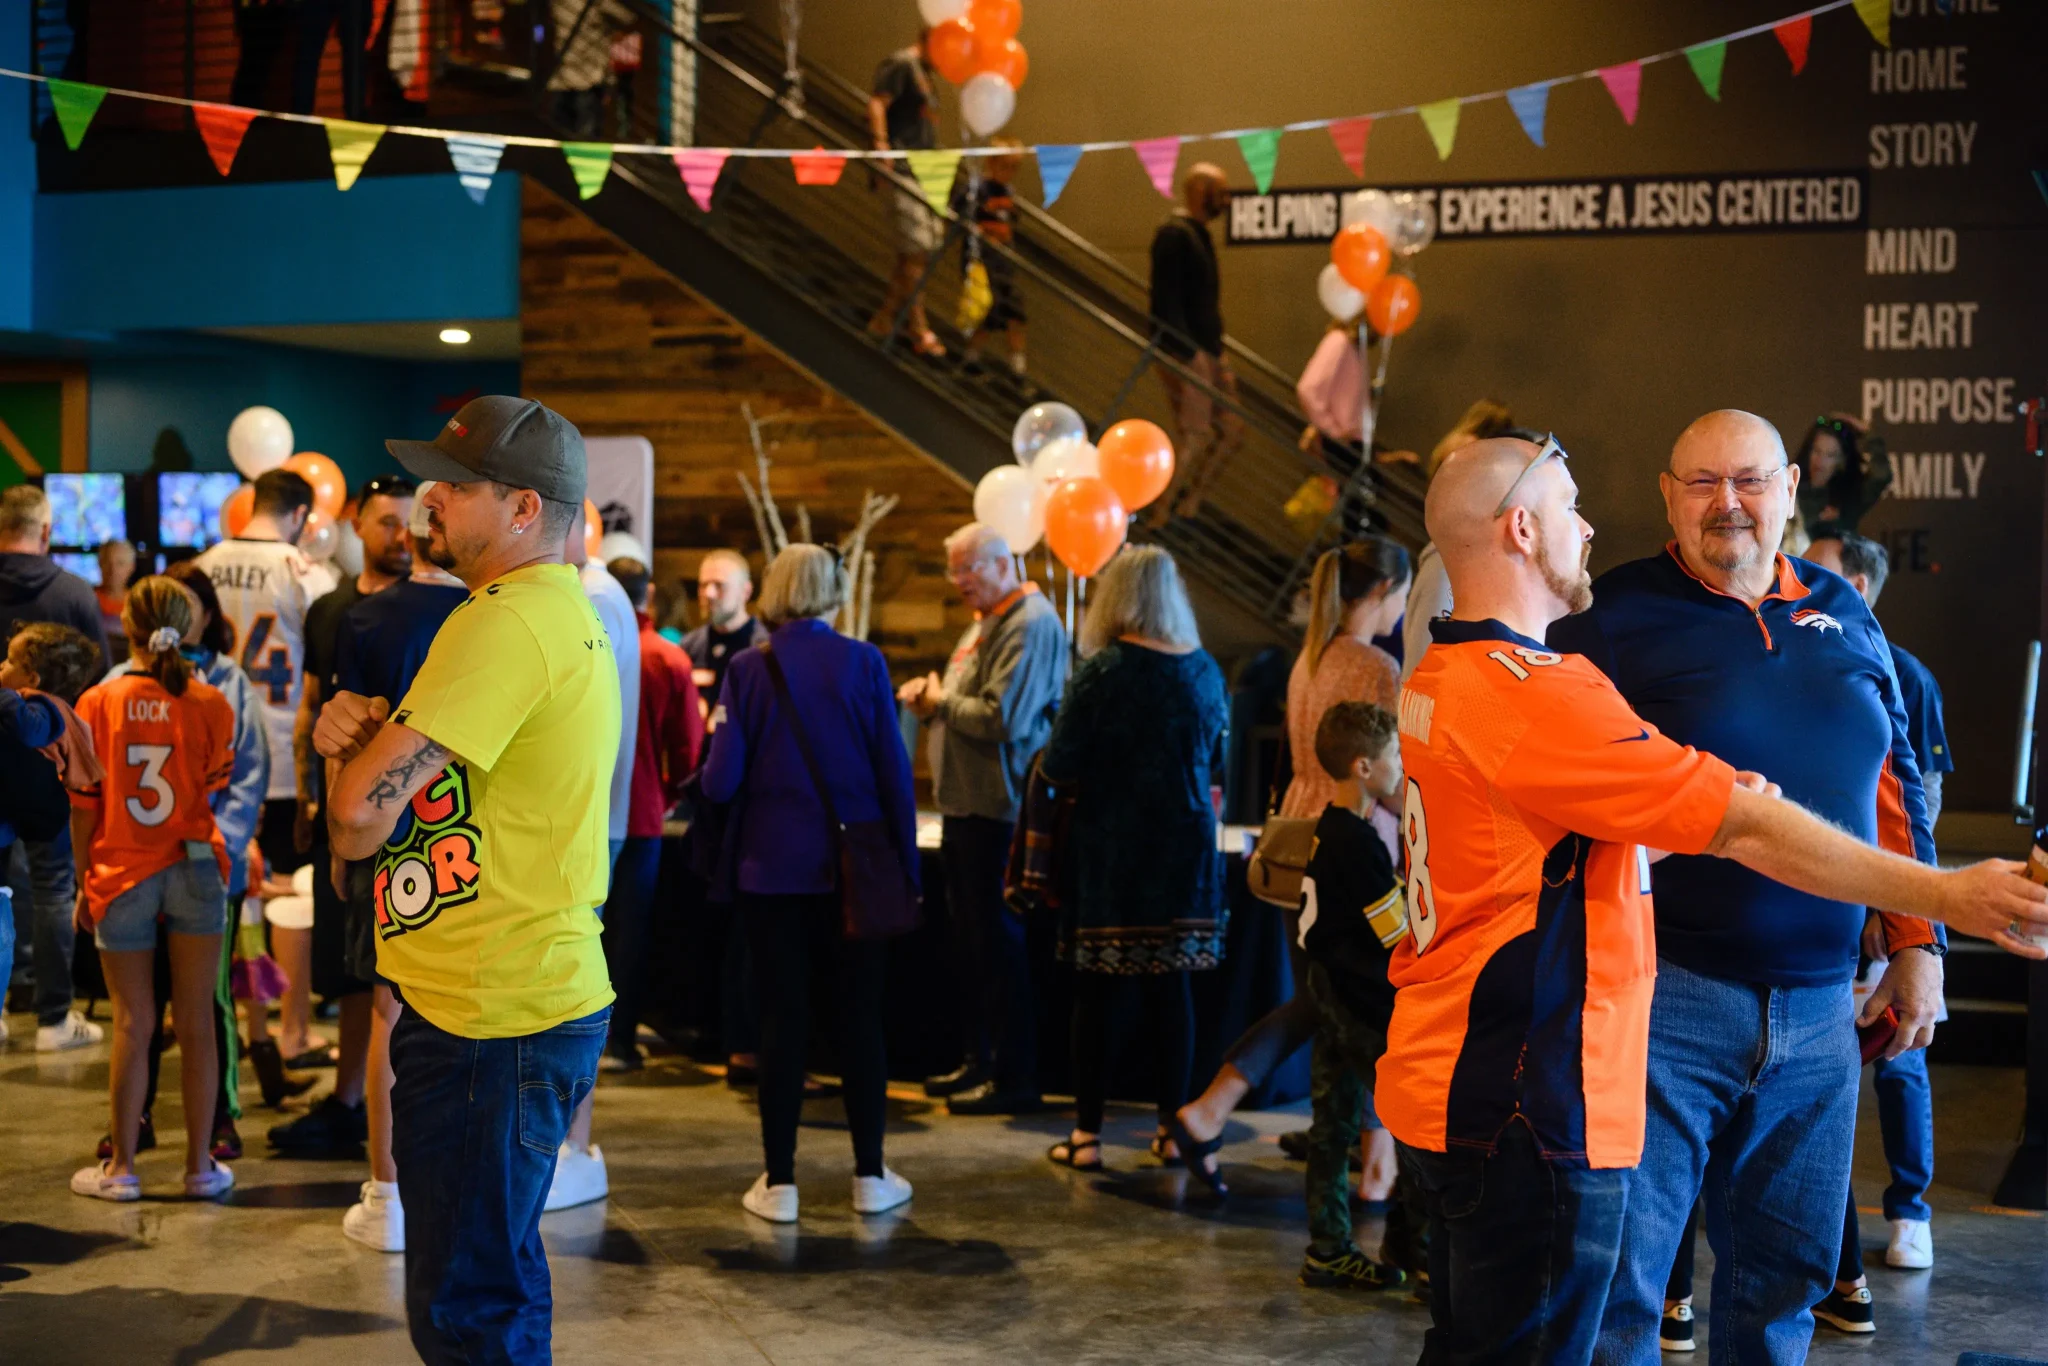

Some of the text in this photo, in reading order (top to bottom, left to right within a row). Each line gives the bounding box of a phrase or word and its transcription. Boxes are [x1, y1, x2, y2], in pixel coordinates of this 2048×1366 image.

[1870, 47, 1968, 93] HOME
[1868, 121, 1978, 169] STORY
[1230, 192, 1338, 239] HELPING
[1440, 185, 1602, 234] EXPERIENCE
[1605, 184, 1627, 228] A
[1630, 181, 1713, 228] JESUS
[1717, 177, 1861, 225] CENTERED
[1866, 228, 1957, 274] MIND
[1864, 302, 1979, 350] HEART
[1862, 377, 2016, 424] PURPOSE
[1861, 451, 1986, 500] AMILY
[1486, 648, 1563, 682] 18
[127, 699, 171, 721] LOCK
[126, 744, 175, 828] 3
